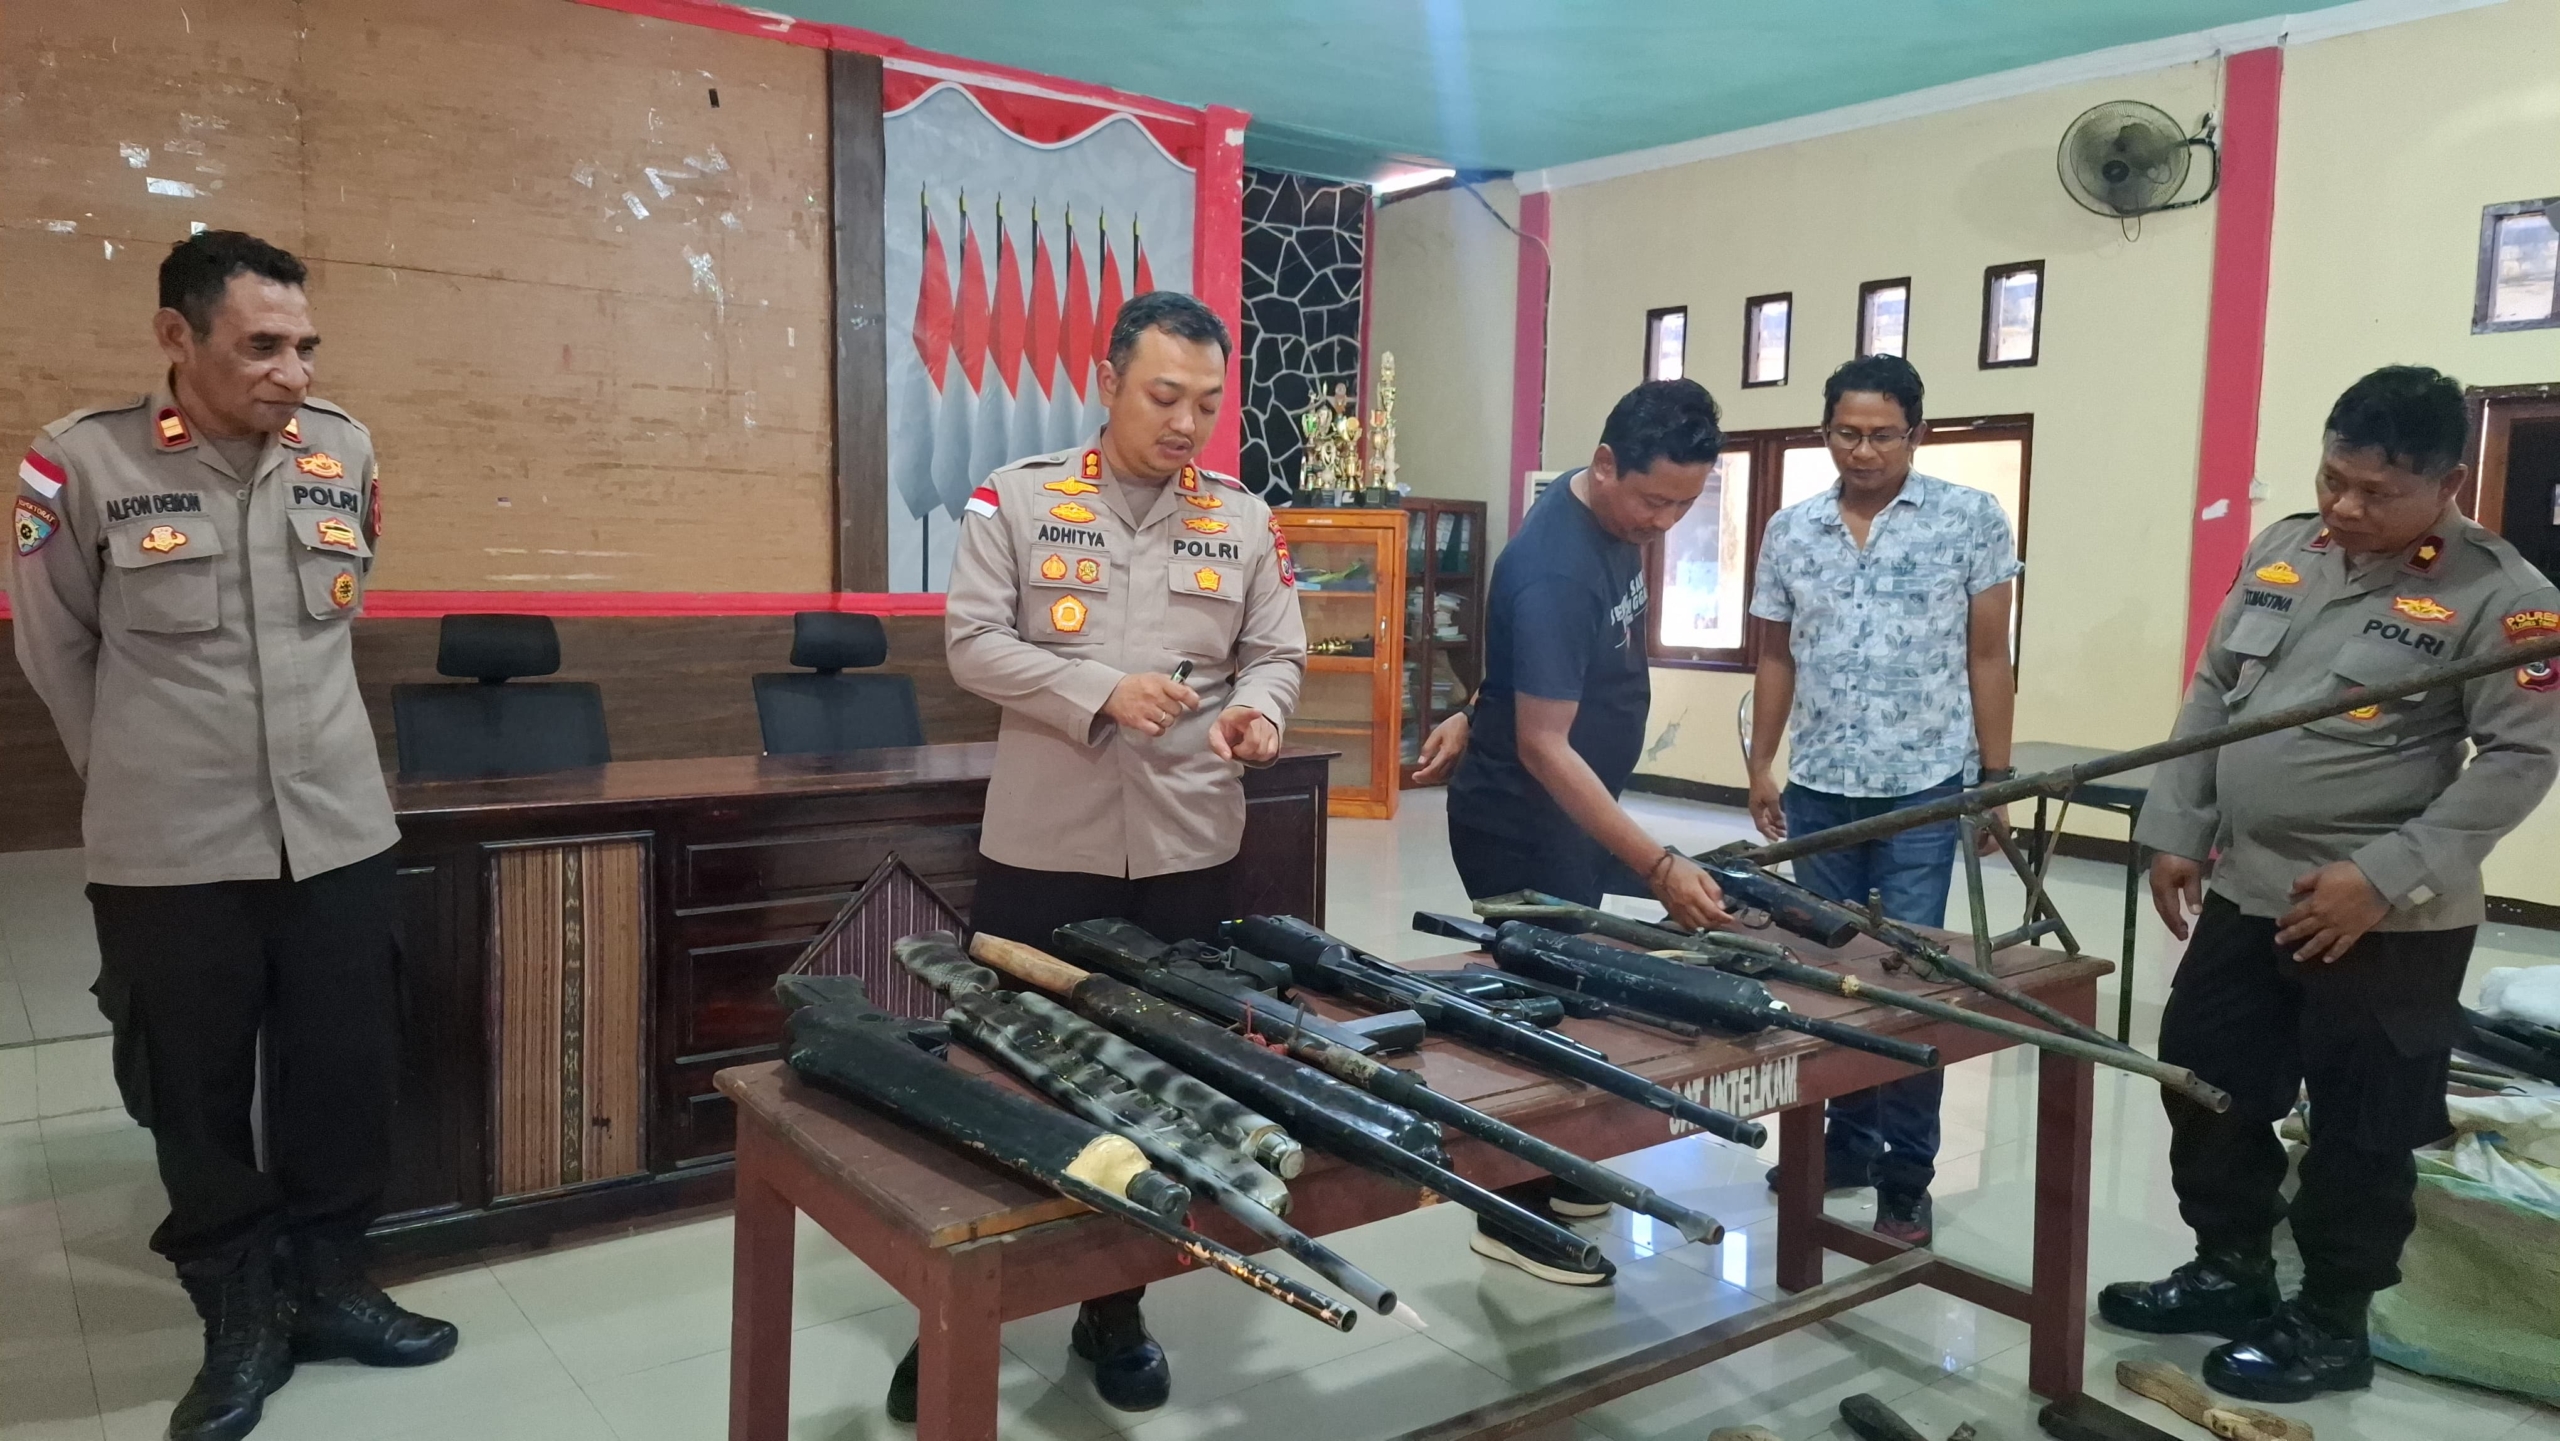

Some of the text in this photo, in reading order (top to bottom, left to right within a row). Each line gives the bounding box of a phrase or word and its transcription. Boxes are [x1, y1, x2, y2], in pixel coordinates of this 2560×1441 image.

[292, 485, 358, 513] POLRI
[1038, 523, 1105, 548] ADHITYA
[1173, 539, 1239, 560] POLRI
[2362, 619, 2446, 657] POLRI
[1709, 1054, 1799, 1118] INTELKAM
